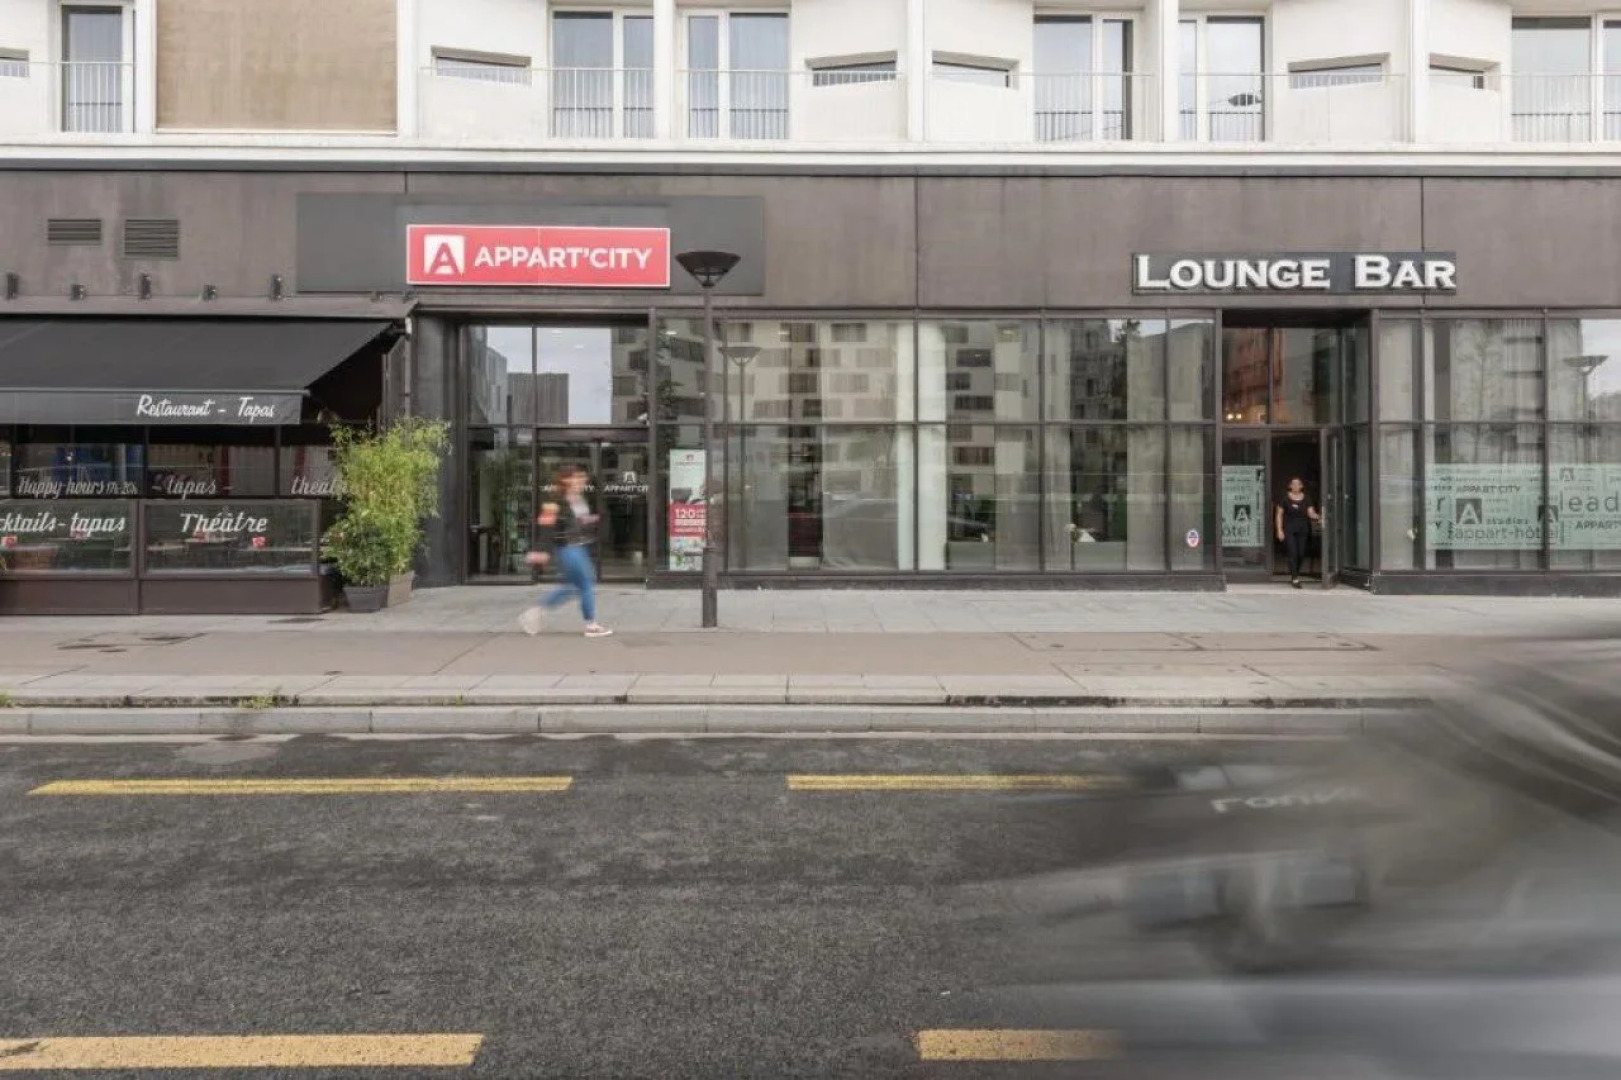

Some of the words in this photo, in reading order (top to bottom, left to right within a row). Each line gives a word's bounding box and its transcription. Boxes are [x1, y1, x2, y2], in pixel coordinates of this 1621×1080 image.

[474, 246, 653, 269] APPART'CITY
[137, 394, 216, 417] Restaurant
[238, 396, 275, 423] Tapas
[165, 475, 217, 500] tapas
[70, 512, 125, 537] tapas
[180, 511, 269, 535] Théâtre
